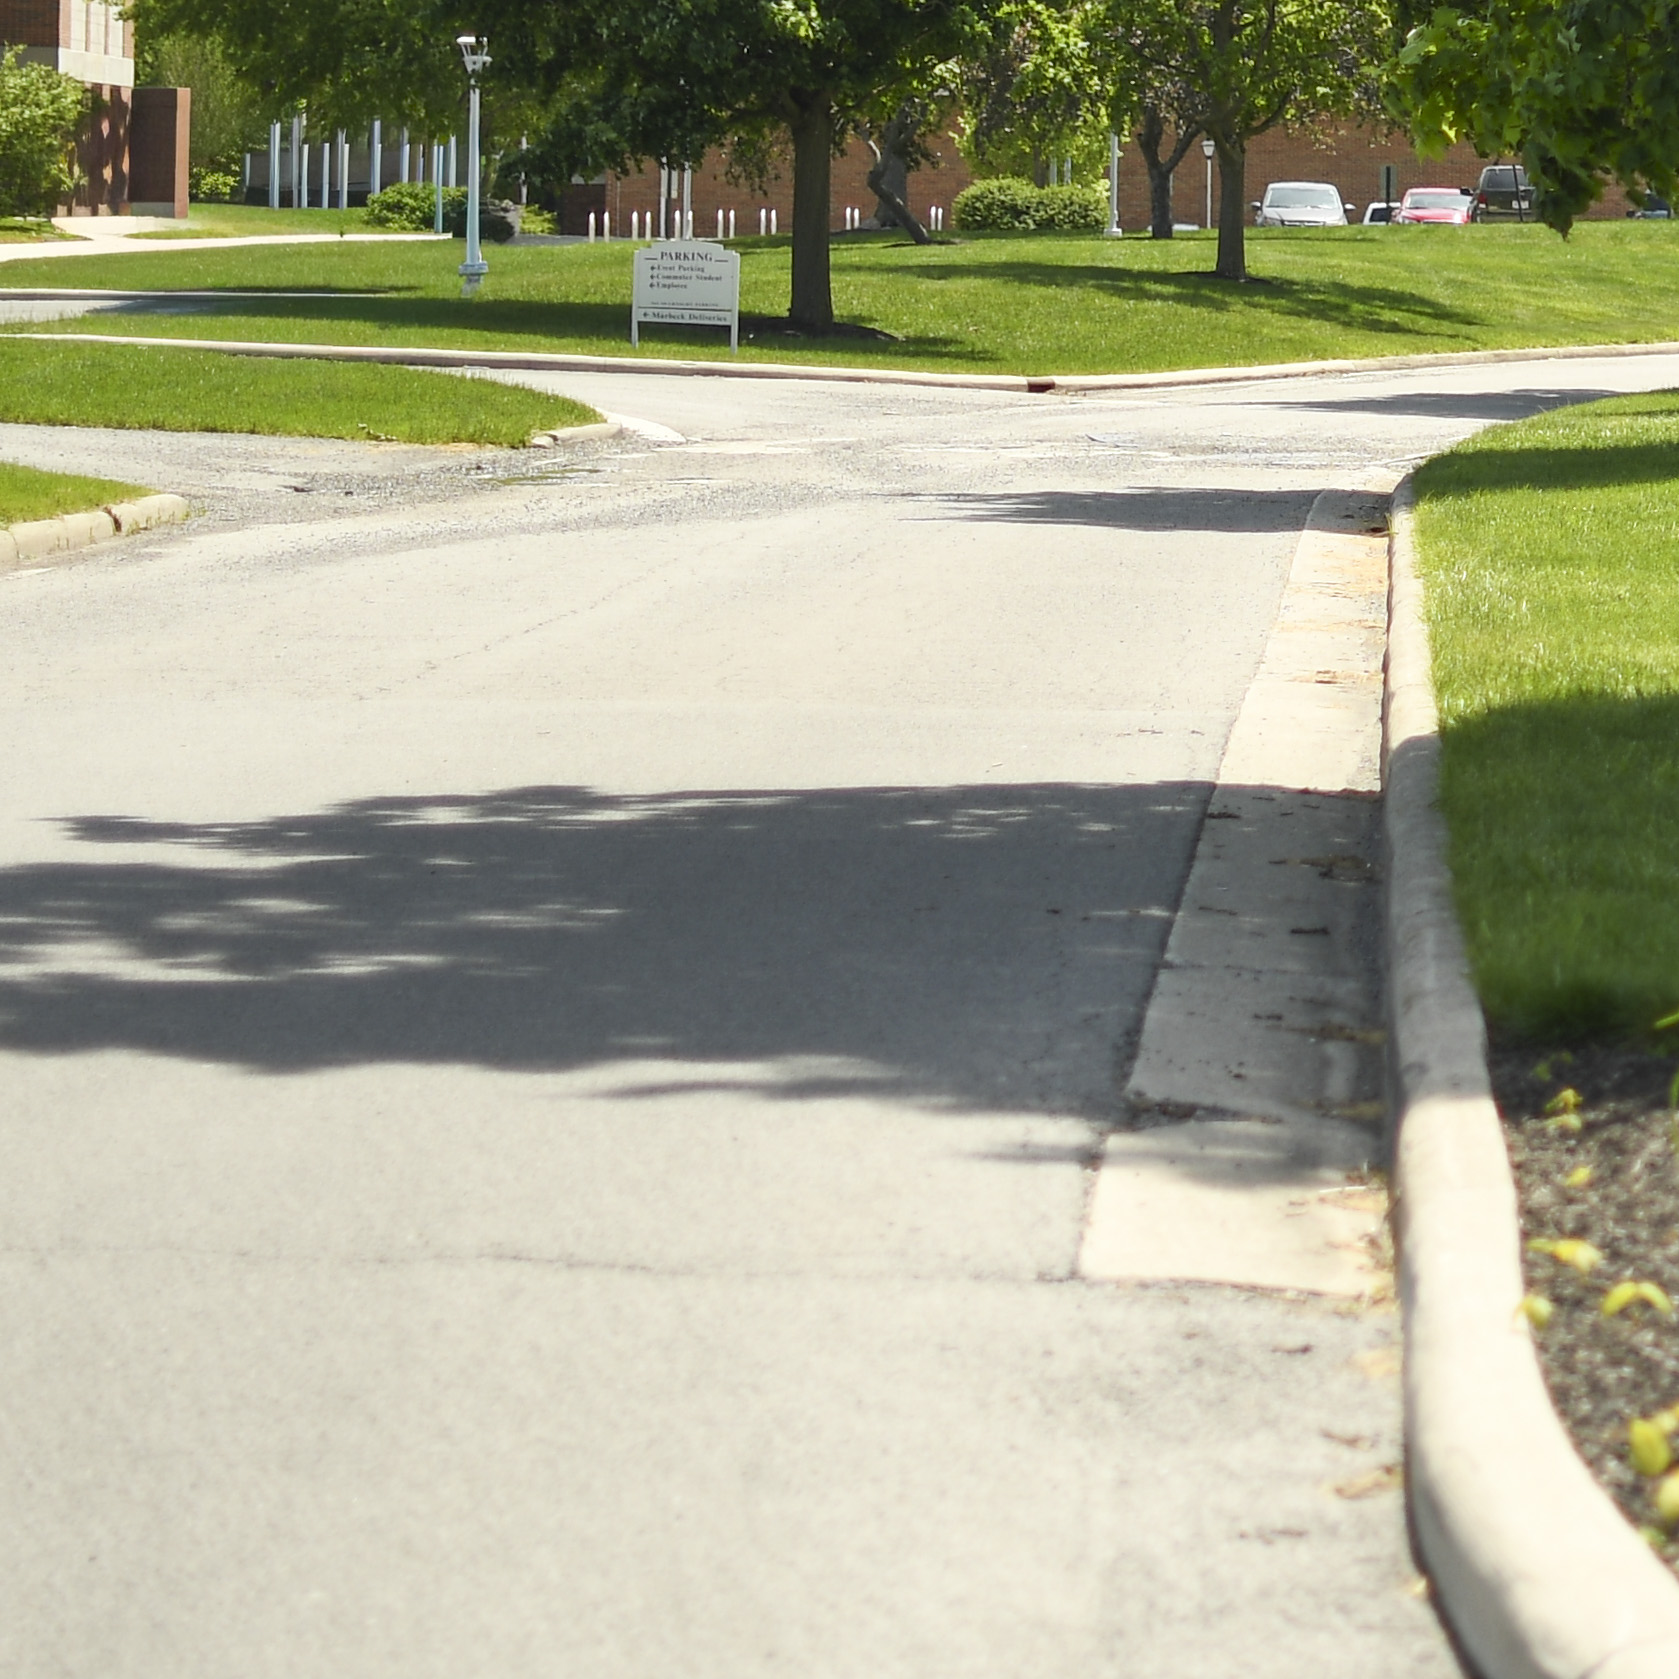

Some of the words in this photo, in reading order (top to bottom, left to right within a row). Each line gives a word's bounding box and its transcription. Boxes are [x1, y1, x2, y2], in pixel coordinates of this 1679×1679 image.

[660, 251, 713, 262] PARKING
[678, 264, 705, 273] Parking
[652, 311, 685, 321] Marbeck
[688, 313, 728, 323] Deliveries
